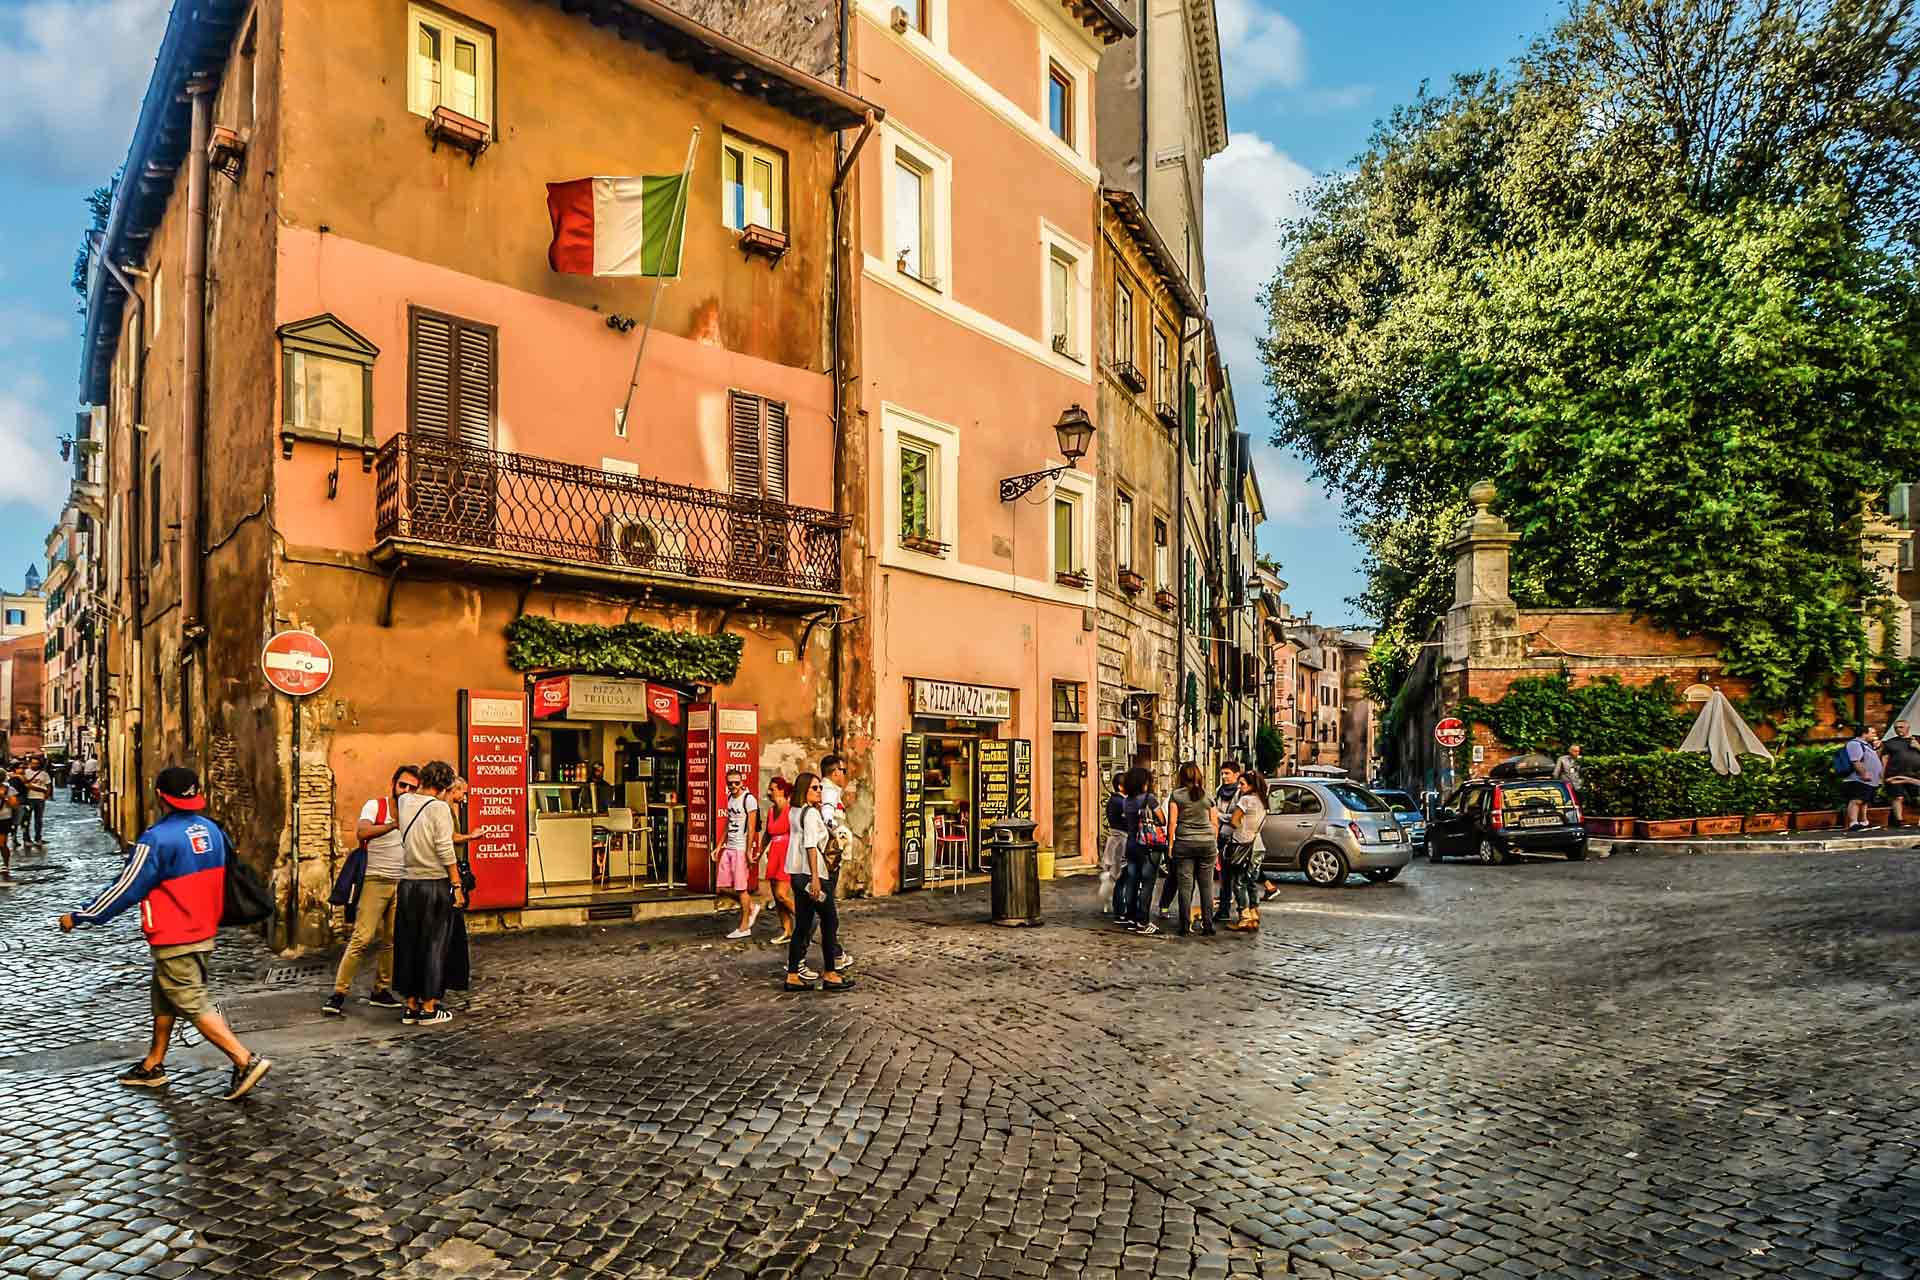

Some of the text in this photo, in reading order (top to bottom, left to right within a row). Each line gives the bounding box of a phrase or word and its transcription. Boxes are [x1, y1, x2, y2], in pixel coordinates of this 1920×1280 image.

[593, 685, 623, 695] PIZZA
[584, 694, 632, 705] TRILUSSA
[472, 735, 523, 744] BEVANDE
[495, 744, 501, 752] E
[726, 741, 750, 750] PIZZA
[472, 754, 522, 763] ALCOLICI
[471, 787, 523, 796] PRODOTTI
[482, 797, 512, 805] TIPICI
[481, 824, 514, 833] DOLCI
[478, 843, 516, 852] GELATI
